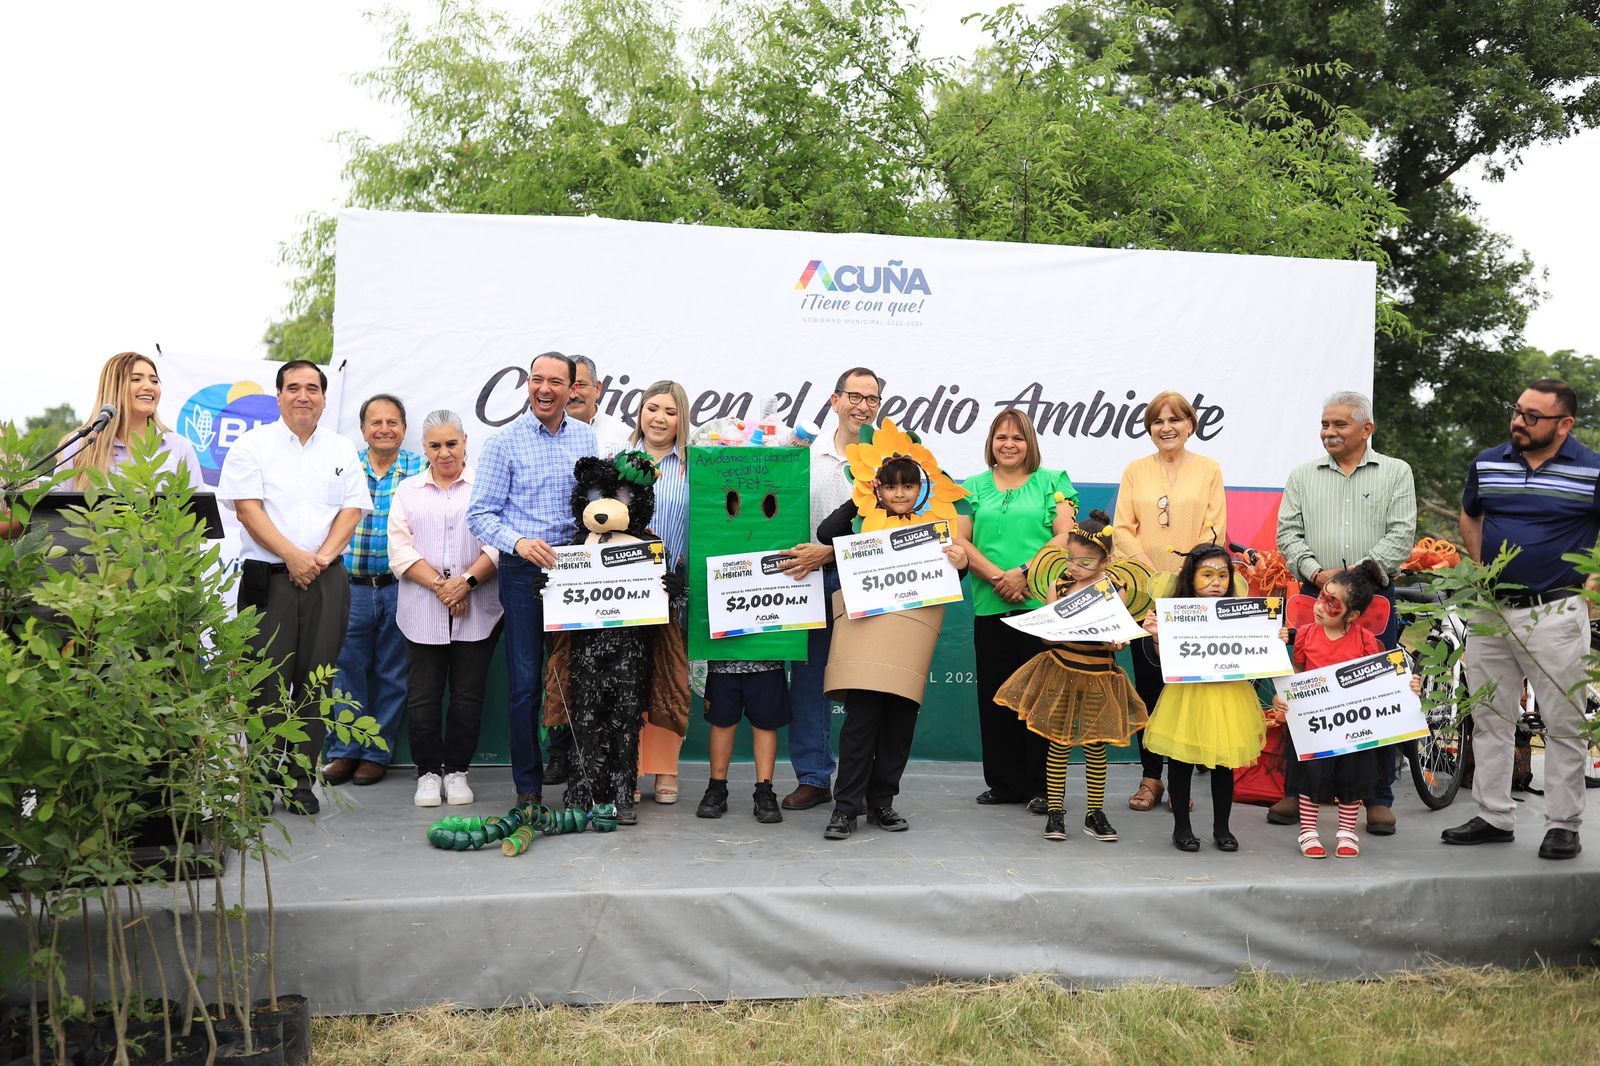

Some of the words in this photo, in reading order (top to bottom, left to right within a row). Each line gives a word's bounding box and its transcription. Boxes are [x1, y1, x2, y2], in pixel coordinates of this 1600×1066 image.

[794, 259, 932, 295] ACUÑA
[801, 294, 850, 310] ¡Tiene
[855, 300, 883, 311] con
[888, 299, 925, 317] que!
[844, 318, 884, 326] MUNICIPAL
[994, 381, 1225, 441] Ambiete
[904, 531, 928, 541] LUGAR
[615, 550, 642, 559] LUGAR
[862, 570, 918, 592] $1,000
[921, 569, 943, 580] M.N
[563, 587, 625, 604] $3,000
[627, 590, 650, 599] M.N
[726, 593, 784, 612] $2,000
[786, 596, 808, 605] M.N
[1068, 594, 1092, 610] LUGAR
[1232, 603, 1259, 612] LUGAR
[1180, 642, 1242, 658] $2,000
[1352, 663, 1382, 678] LUGAR
[1283, 686, 1330, 700] AMBIENTAL
[1308, 706, 1371, 734] $1,000
[1376, 704, 1401, 718] M.N
[1345, 729, 1373, 740] ACUÑA
